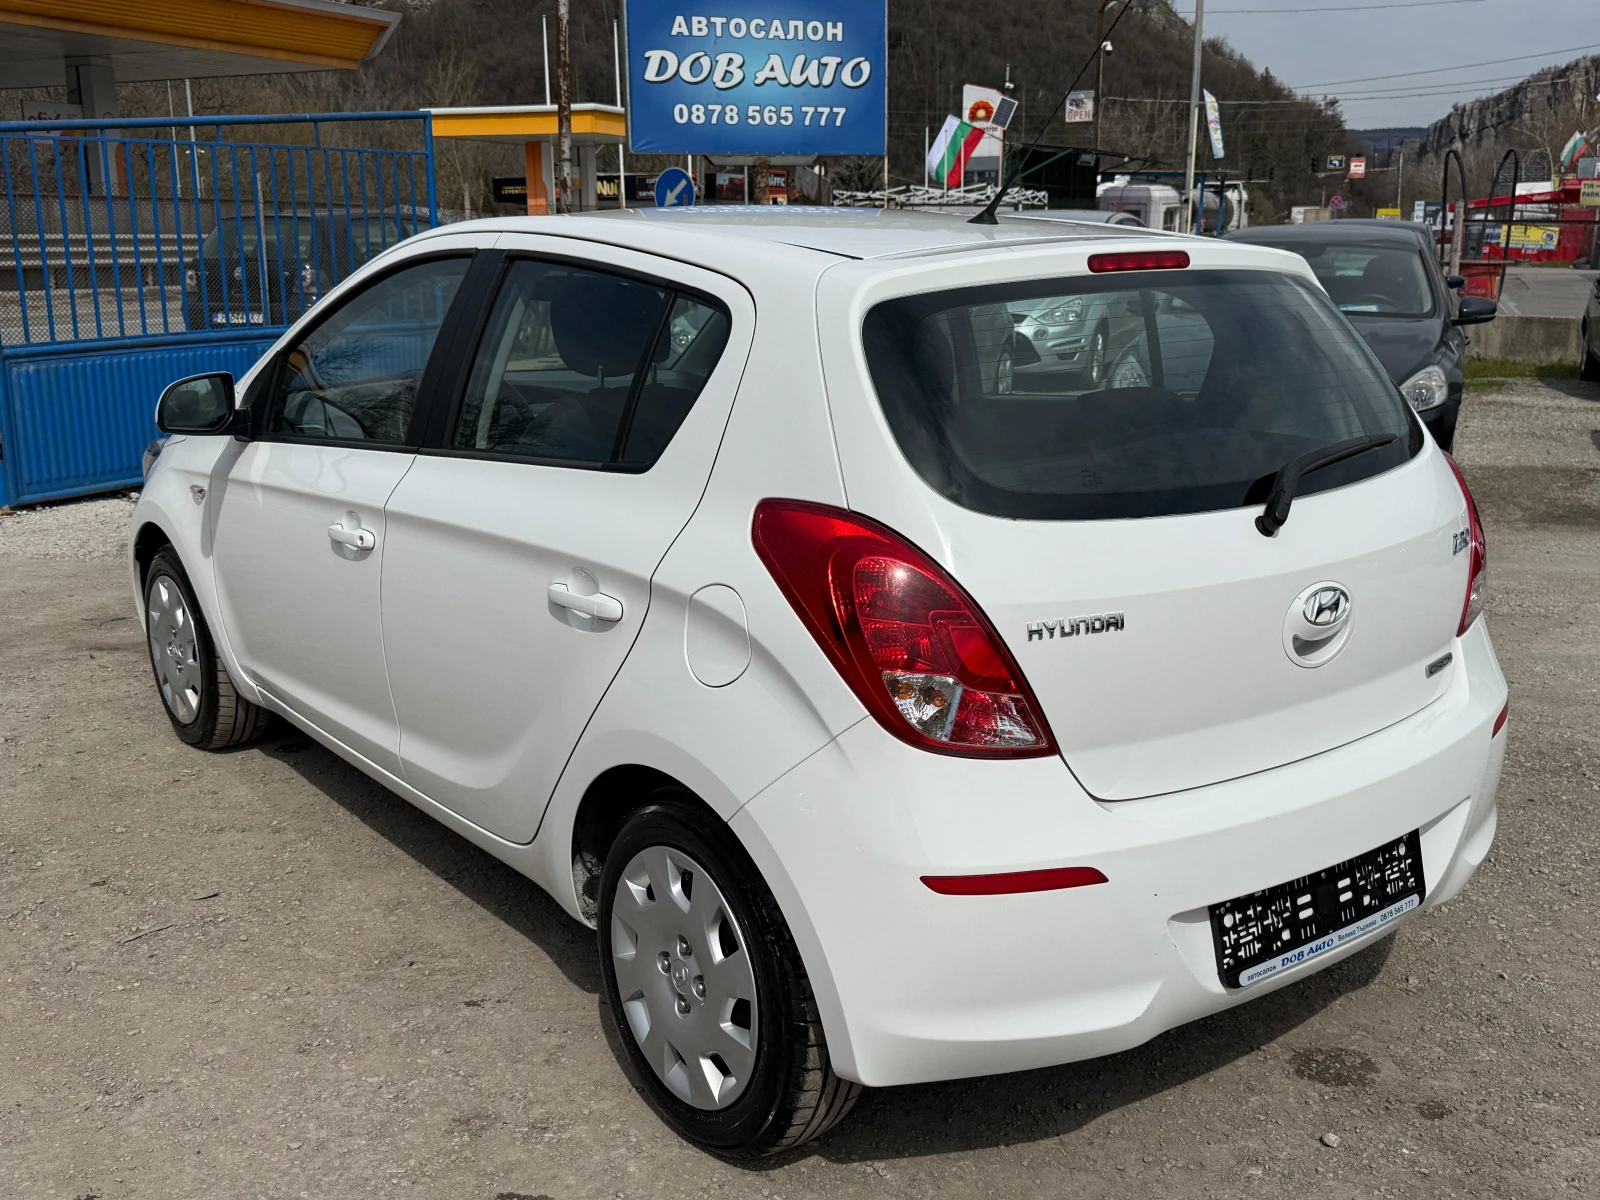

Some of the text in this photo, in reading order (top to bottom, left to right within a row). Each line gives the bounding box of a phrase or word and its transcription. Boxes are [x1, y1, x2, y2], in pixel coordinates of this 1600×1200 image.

[670, 15, 844, 42] АВТОСАЛОН
[643, 50, 871, 89] DOB AUTO
[673, 103, 847, 127] 0878 565 777
[1067, 109, 1091, 121] OPEN
[1583, 182, 1595, 190] TIR
[1026, 611, 1125, 642] HYUNDAI
[1247, 964, 1277, 982] автосалон
[1280, 950, 1305, 967] DOB
[1307, 938, 1334, 957] AUTO
[1380, 910, 1394, 922] 0878
[1394, 904, 1404, 915] 565
[1404, 899, 1414, 910] 777
